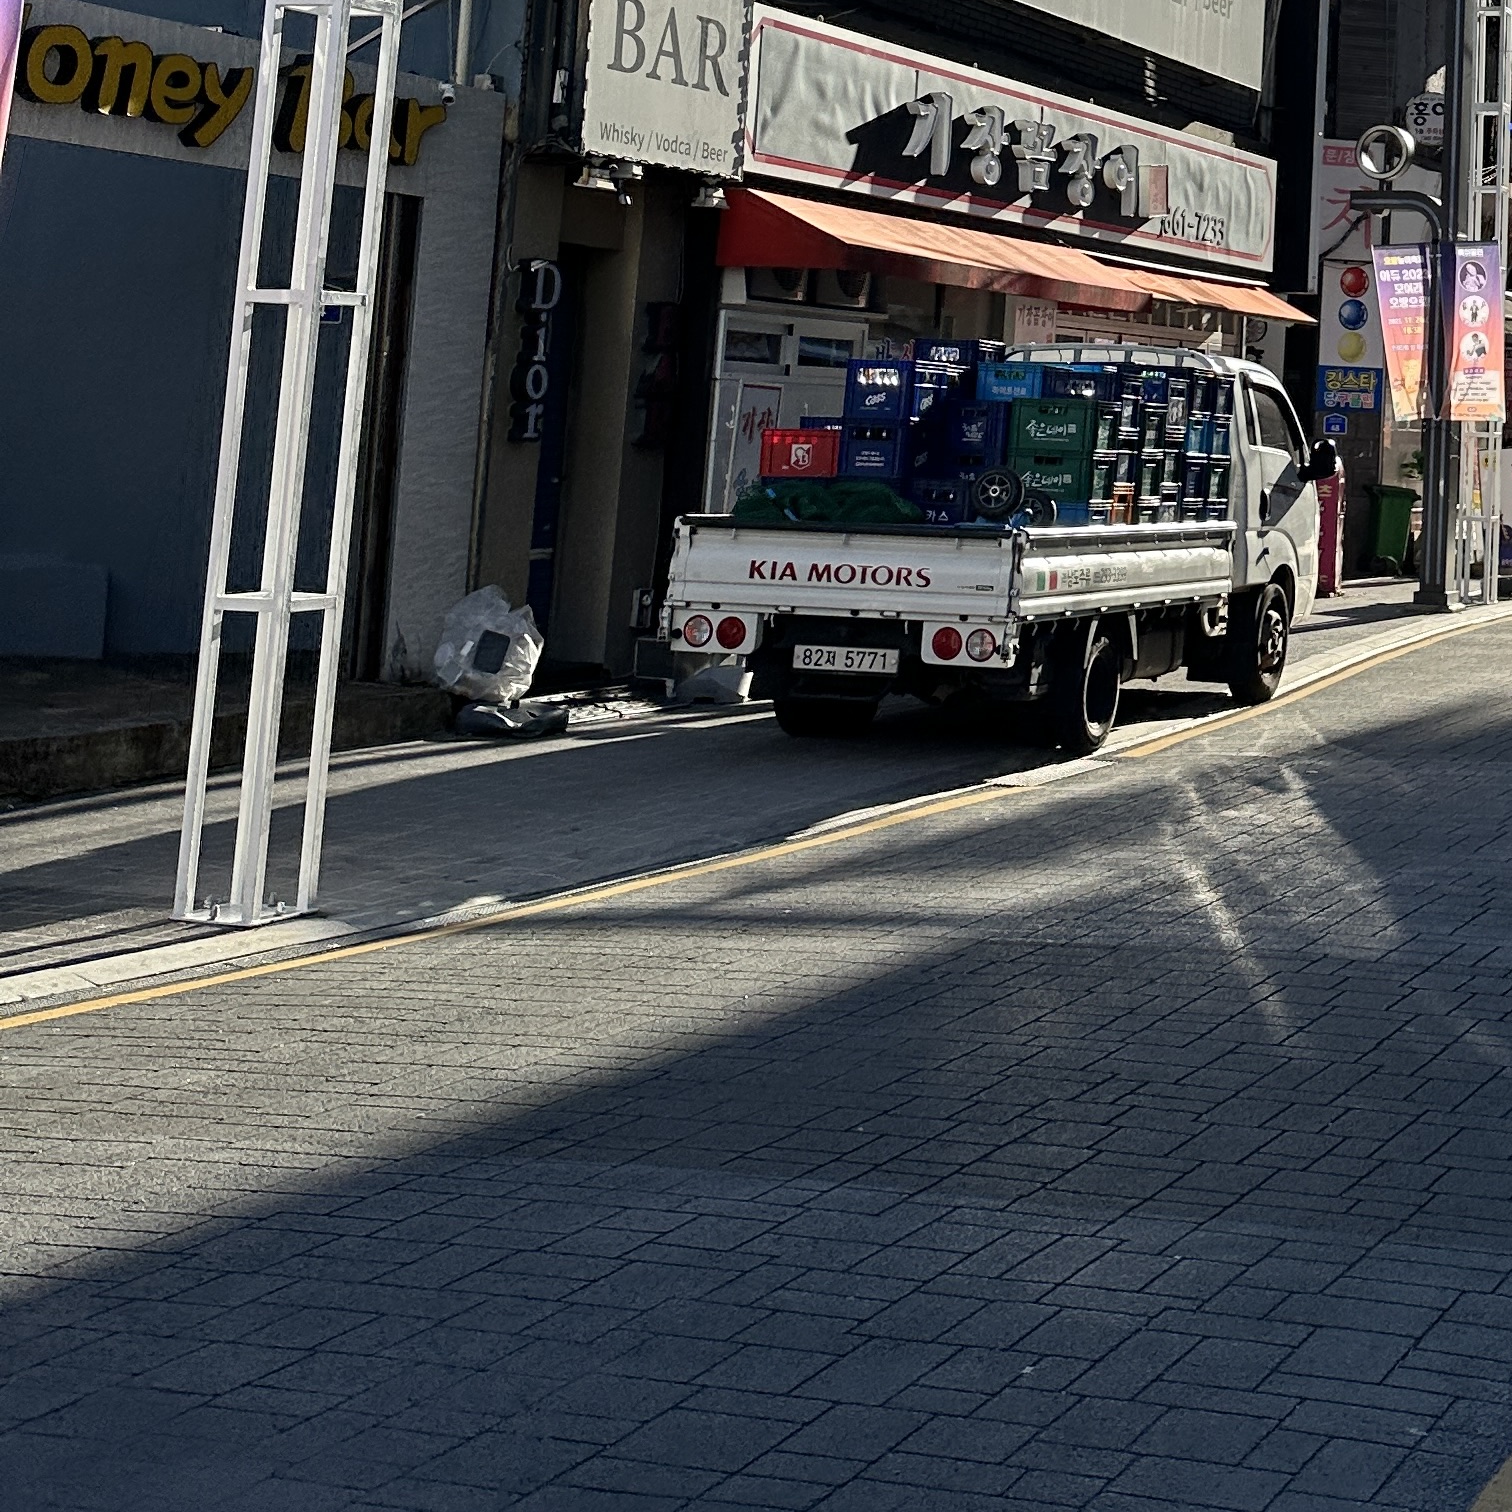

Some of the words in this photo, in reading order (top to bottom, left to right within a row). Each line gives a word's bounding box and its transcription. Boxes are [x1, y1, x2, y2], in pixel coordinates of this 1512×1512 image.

[600, 121, 645, 153] Whisky
[655, 132, 692, 157] Vodca
[701, 141, 729, 164] Beer
[902, 91, 1139, 219] 기장꼼장어
[1326, 371, 1377, 392] 킹스타
[865, 391, 887, 406] Cass
[925, 509, 949, 522] 카스
[748, 559, 799, 584] KIA
[807, 562, 932, 588] MOTORS
[844, 649, 888, 671] 5771
